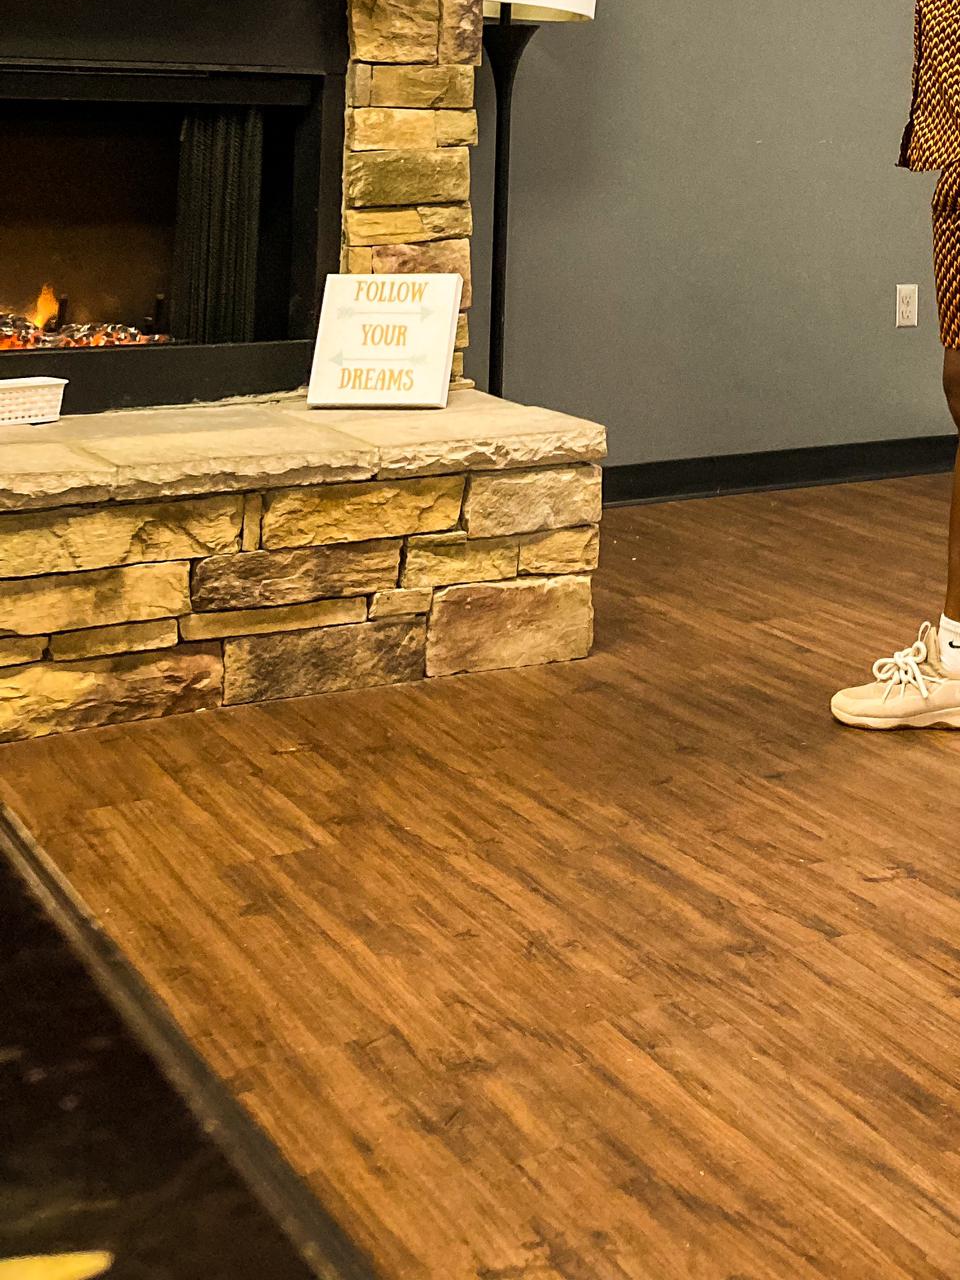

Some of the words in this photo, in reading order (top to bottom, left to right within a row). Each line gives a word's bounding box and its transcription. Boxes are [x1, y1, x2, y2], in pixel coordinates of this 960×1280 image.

[353, 280, 429, 303] FOLLOW
[361, 323, 408, 346] YOUR
[337, 367, 415, 392] DREAMS
